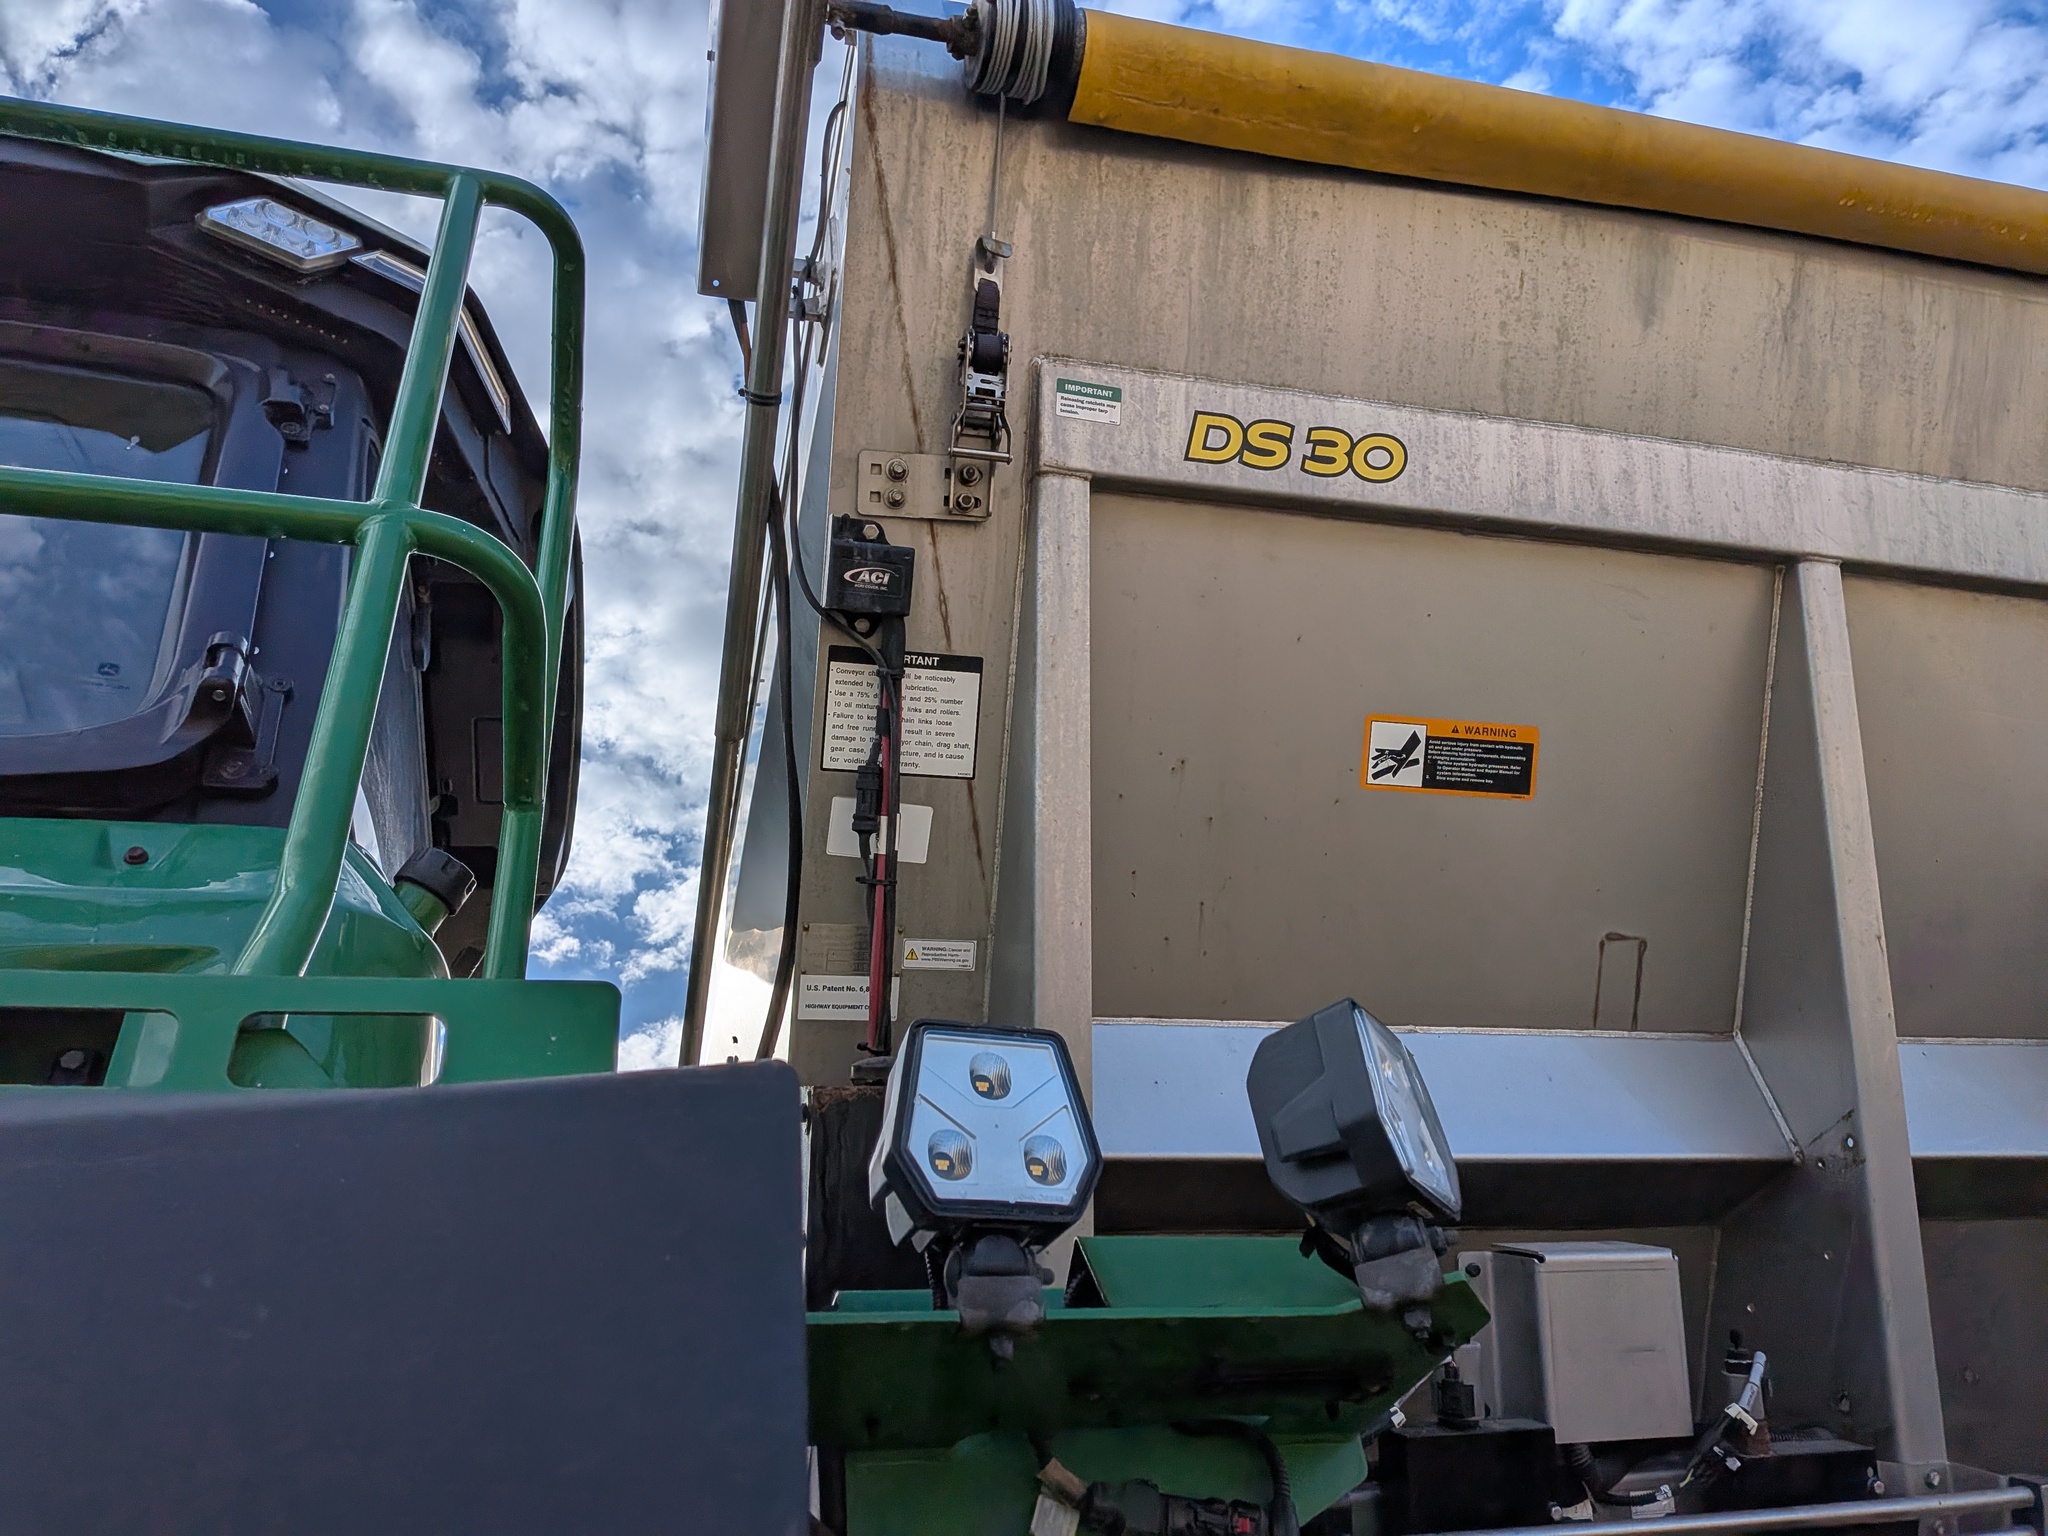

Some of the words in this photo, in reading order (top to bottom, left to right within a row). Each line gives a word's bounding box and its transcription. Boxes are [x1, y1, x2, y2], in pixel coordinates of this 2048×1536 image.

[1064, 383, 1114, 398] IMPORTANT
[1060, 396, 1085, 404] Releasing
[1183, 409, 1296, 471] DS
[1300, 426, 1409, 484] 30
[856, 570, 890, 585] ACI
[904, 654, 940, 666] RTANT
[835, 667, 866, 676] Conveyor
[924, 675, 956, 684] noticeably
[834, 679, 864, 687] extended
[866, 681, 874, 689] by
[904, 684, 939, 692] lubrication.
[832, 712, 854, 720] Failure
[1464, 726, 1517, 738] WARNING
[830, 734, 856, 743] damage
[914, 740, 934, 748] chain,
[936, 742, 951, 750] drag
[954, 742, 971, 750] shaft,
